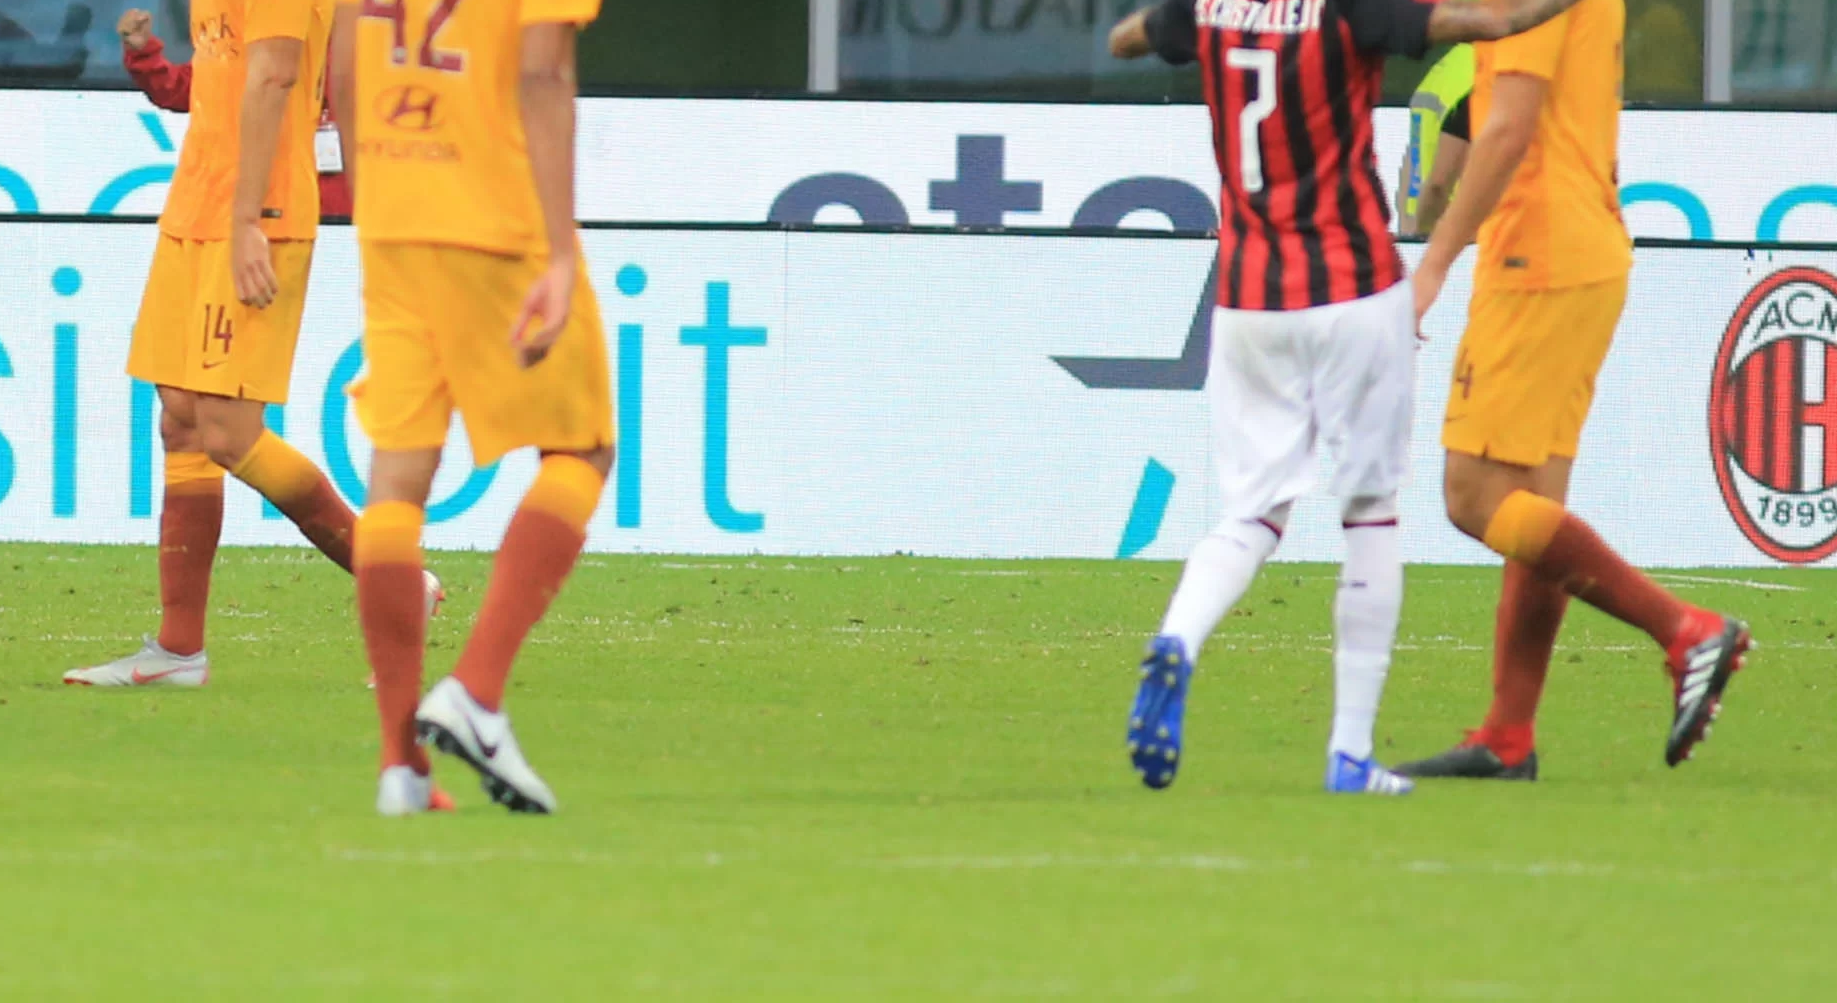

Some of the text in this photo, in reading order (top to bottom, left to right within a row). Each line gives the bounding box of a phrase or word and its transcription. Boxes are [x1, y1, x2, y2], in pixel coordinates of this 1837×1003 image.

[1225, 46, 1278, 193] 7
[202, 303, 234, 355] 14
[1454, 347, 1475, 401] 4
[1757, 495, 1837, 529] 1899
